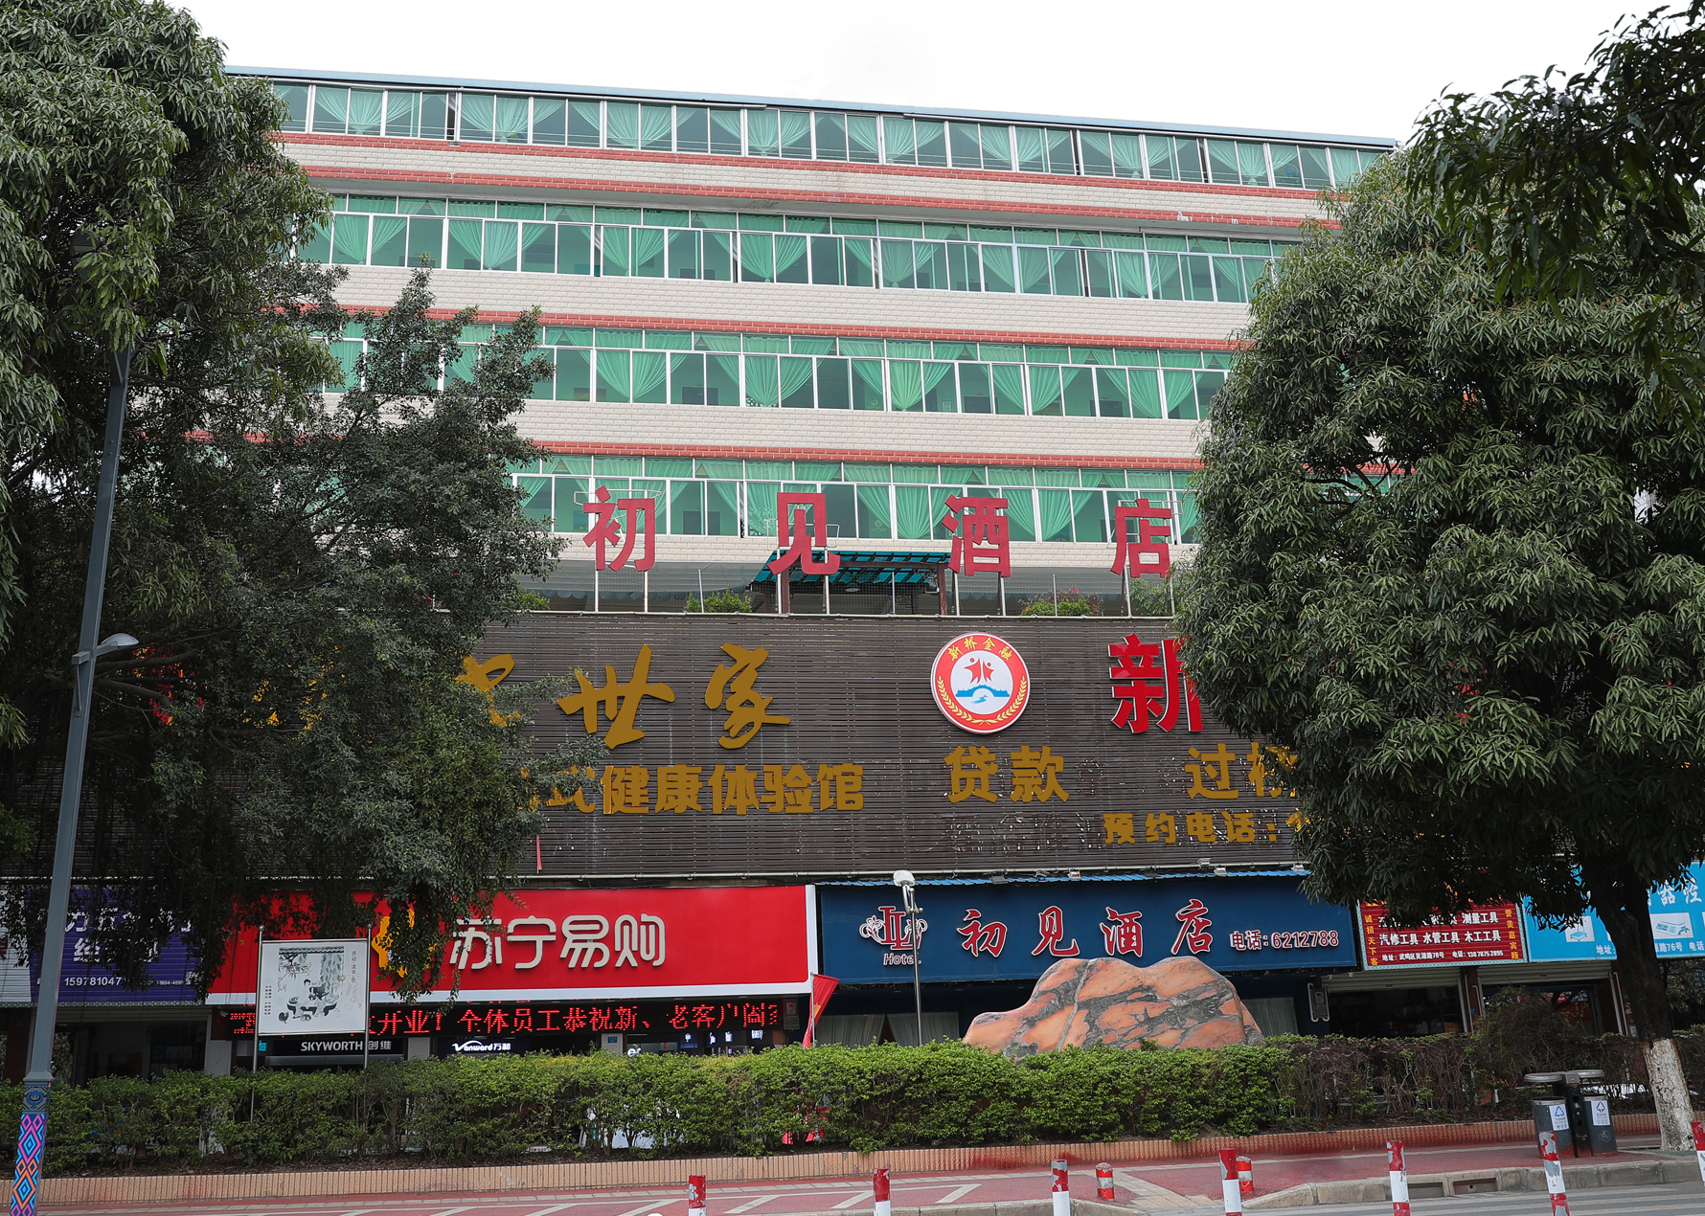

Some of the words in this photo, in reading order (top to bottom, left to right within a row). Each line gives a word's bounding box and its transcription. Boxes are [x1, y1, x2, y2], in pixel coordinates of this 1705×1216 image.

[583, 486, 1172, 578] 初见酒店
[947, 635, 1013, 662] 新桥金融
[944, 745, 1070, 804] 贷款
[1462, 911, 1499, 925] 测量工具
[956, 898, 1214, 958] 初见酒店
[450, 913, 666, 971] 苏宁易购
[1379, 933, 1419, 946] 汽修工具
[1422, 931, 1460, 945] 水管工具
[1464, 929, 1502, 943] 木工工具
[883, 953, 922, 965] Hote
[64, 976, 126, 987] 159781047
[301, 1041, 363, 1052] SKYWORTH
[368, 1040, 392, 1051] 创维
